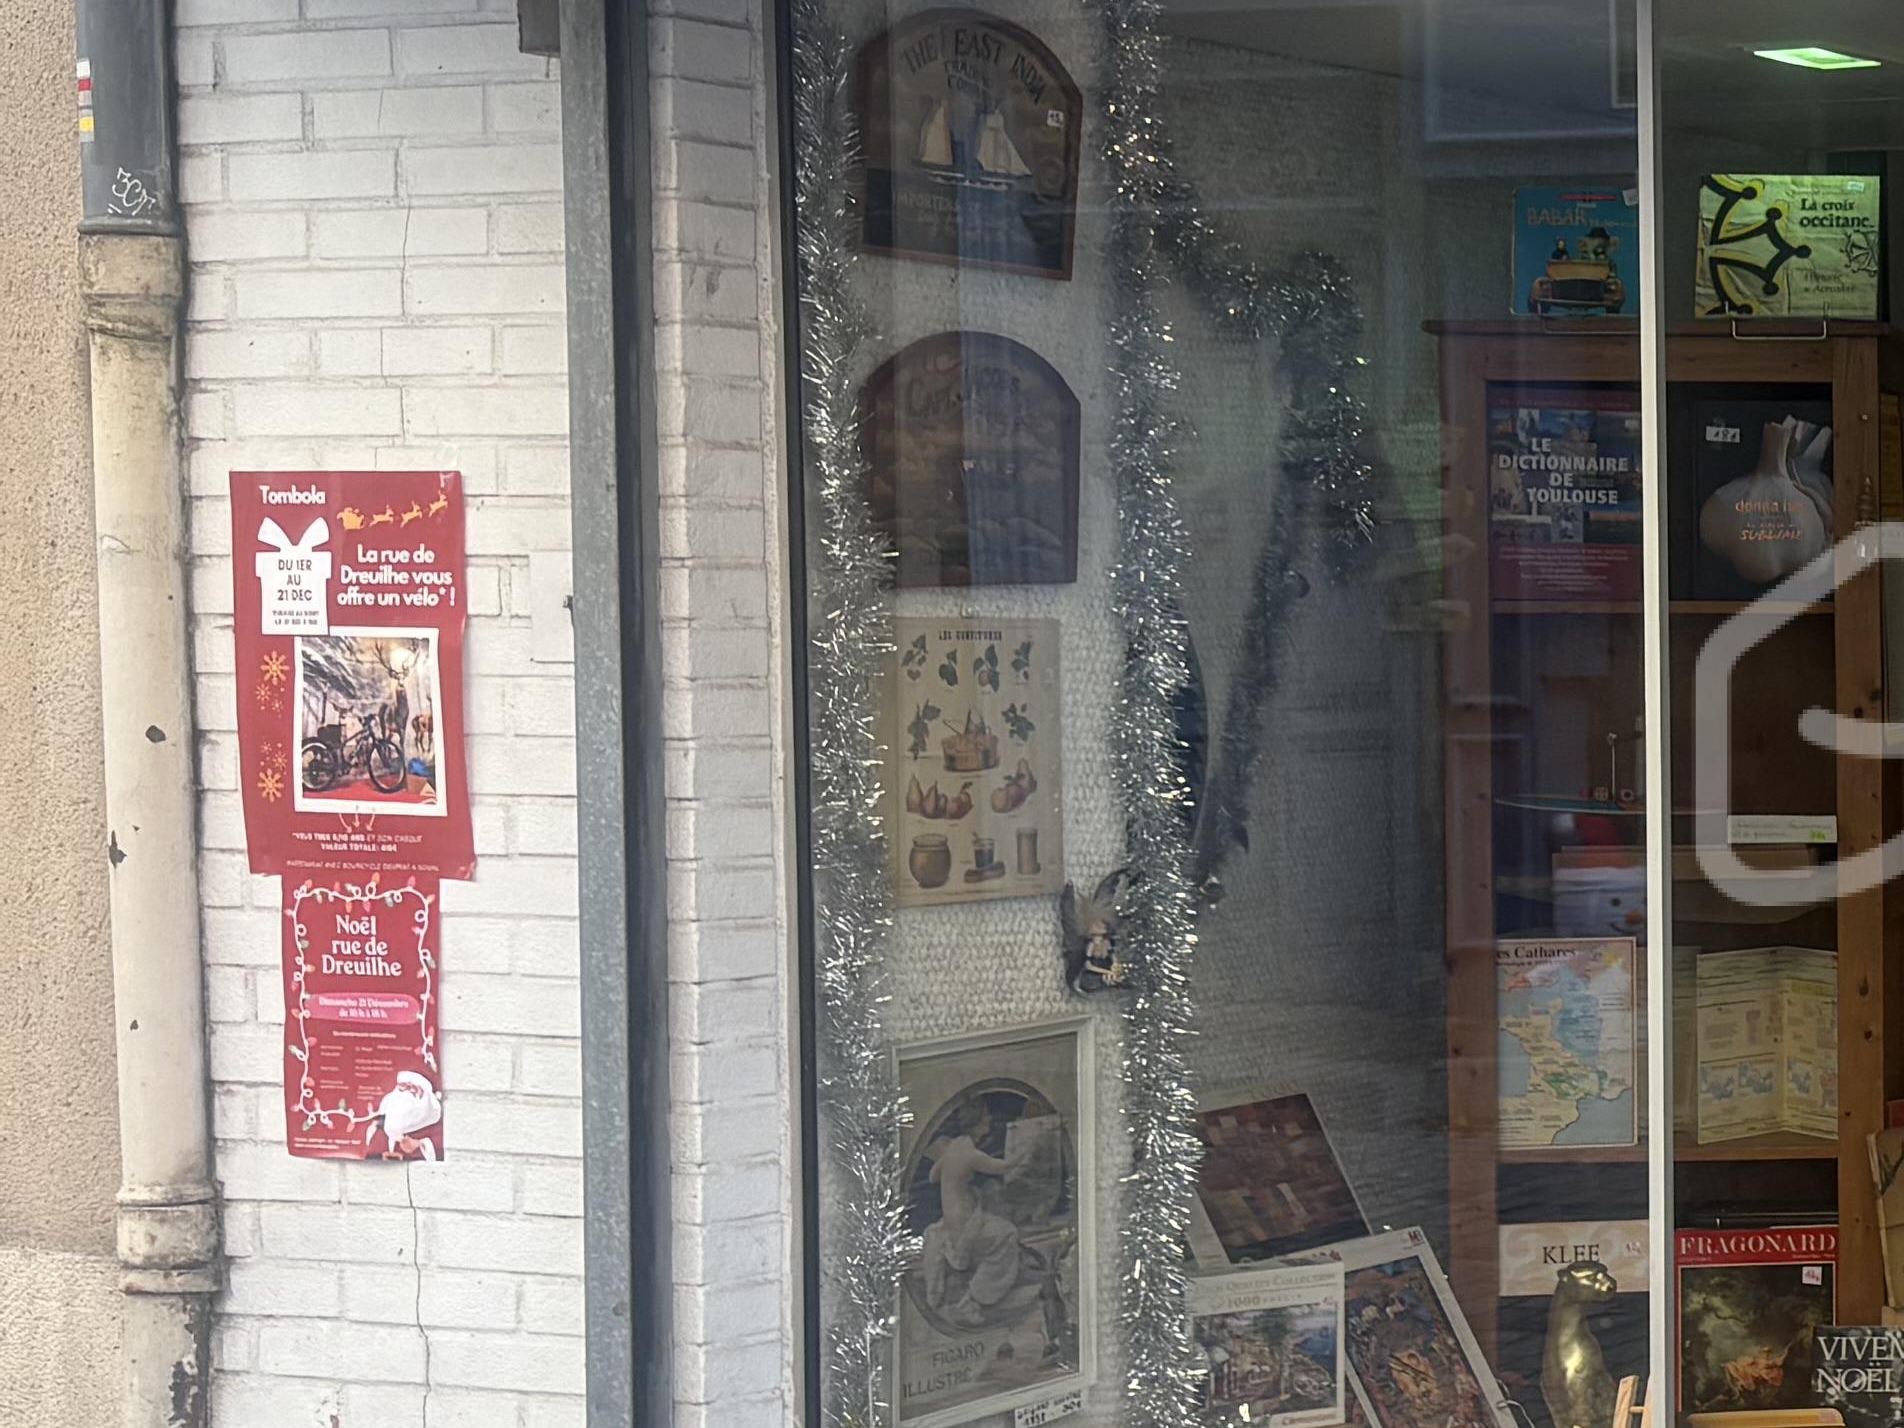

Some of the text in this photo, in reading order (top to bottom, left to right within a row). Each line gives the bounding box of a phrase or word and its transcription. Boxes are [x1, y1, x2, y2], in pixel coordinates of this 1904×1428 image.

[954, 28, 1006, 64] EAST
[1801, 198, 1856, 211] La croix
[1800, 213, 1870, 228] occitane
[1531, 438, 1552, 452] LE
[1499, 454, 1629, 472] DICTIONNAIRE
[1549, 473, 1573, 487] DE
[259, 484, 326, 505] Tombola
[1526, 488, 1619, 504] TOULOUSE
[357, 543, 435, 563] La rue de
[278, 559, 293, 571] DU
[286, 574, 302, 586] AU
[341, 565, 453, 586] Dreuilhe vous
[277, 590, 313, 601] 21 DEC
[337, 586, 374, 606] offre
[377, 591, 400, 606] un
[336, 915, 376, 936] Noël
[332, 937, 388, 956] rue de
[1515, 946, 1577, 959] Cathares
[322, 955, 402, 977] Dreuilhe
[1543, 1244, 1599, 1263] KLEE
[1680, 1234, 1836, 1255] FRAGONARD
[1816, 1361, 1901, 1393] NOËL
